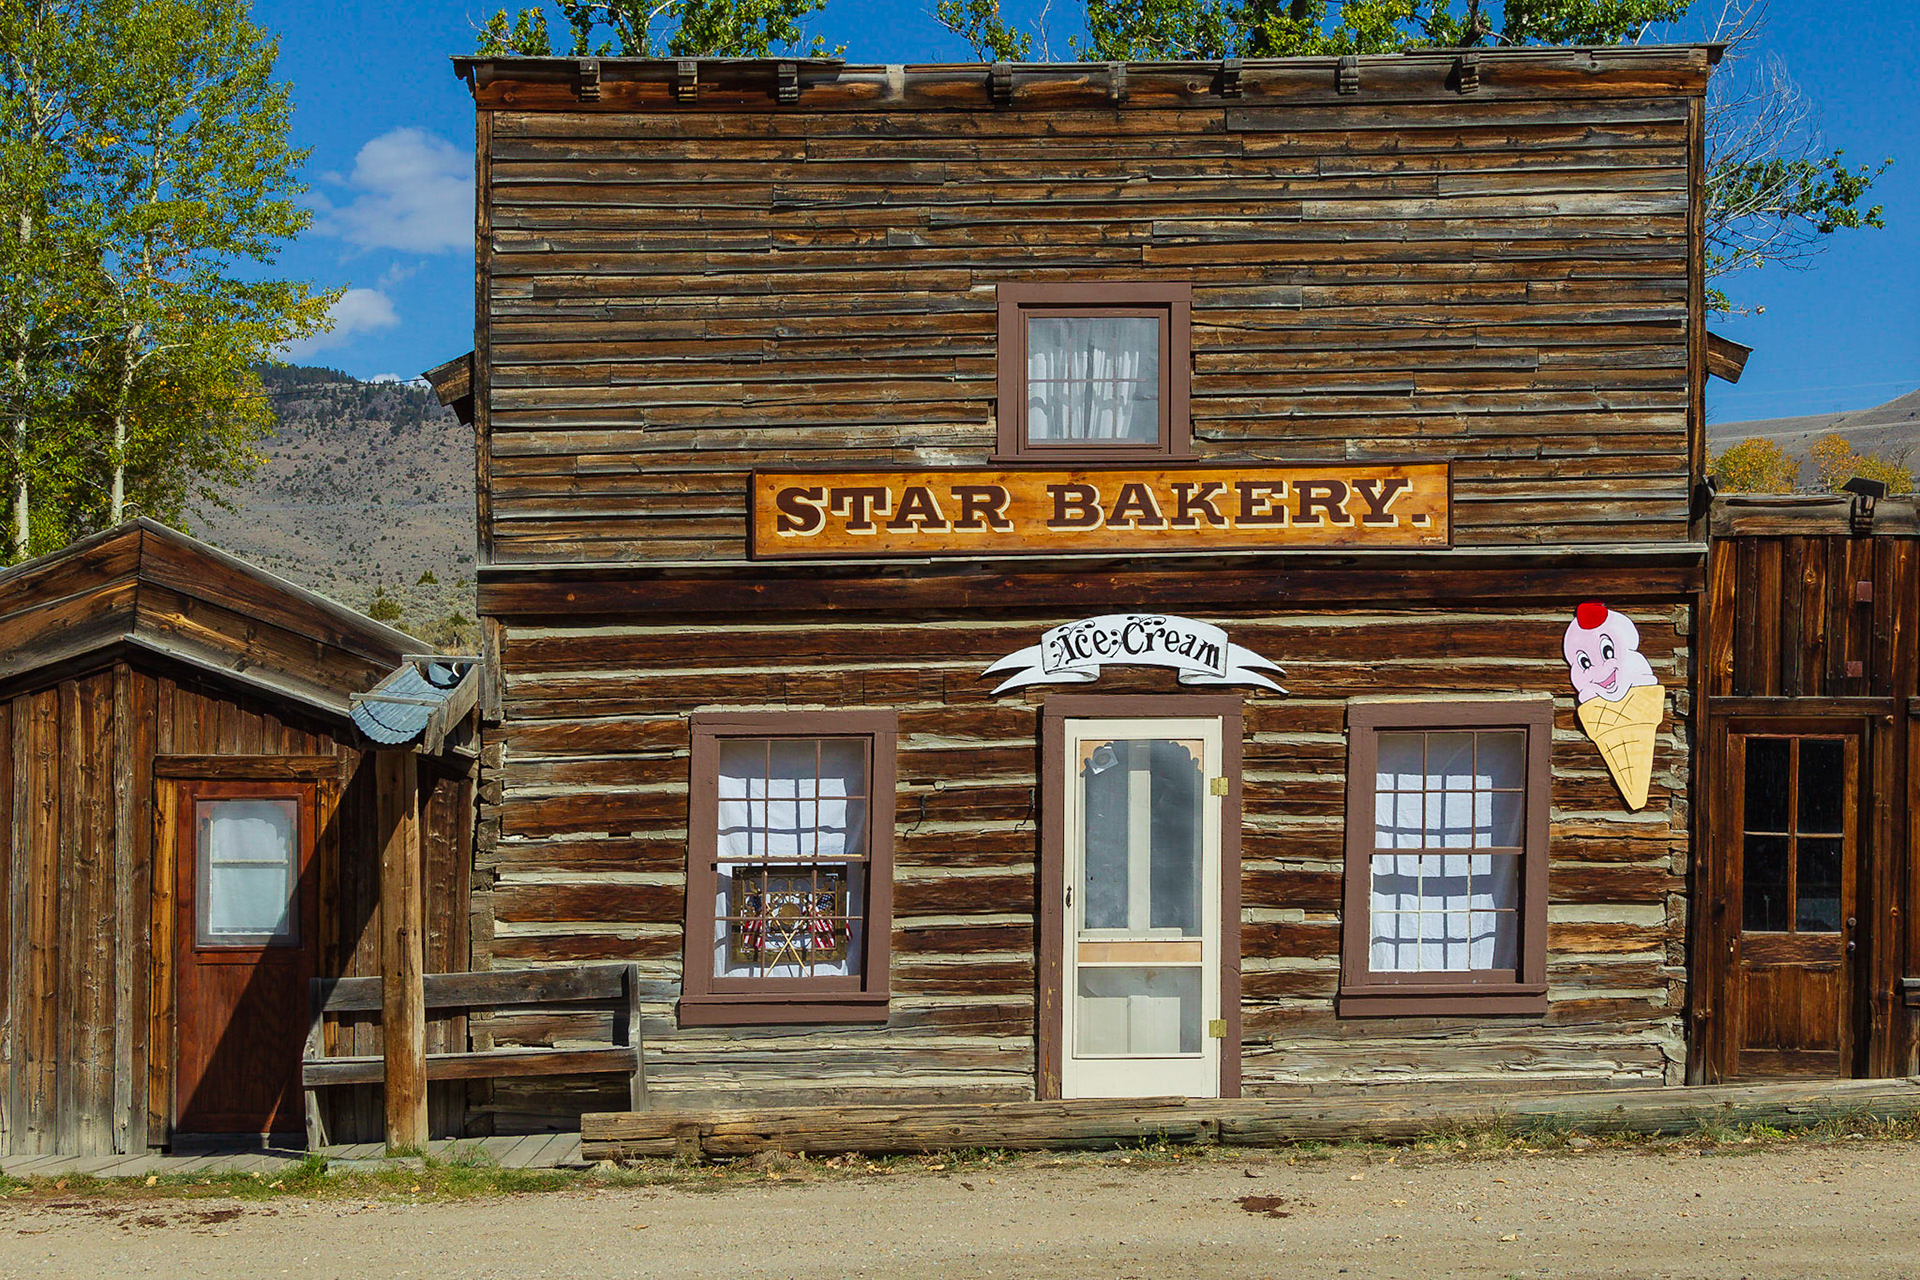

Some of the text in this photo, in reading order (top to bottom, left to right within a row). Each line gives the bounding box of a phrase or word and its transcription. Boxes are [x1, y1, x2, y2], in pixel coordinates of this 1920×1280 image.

[776, 479, 1431, 537] STAR BAKERY.
[1051, 616, 1220, 670] Ice Cream
